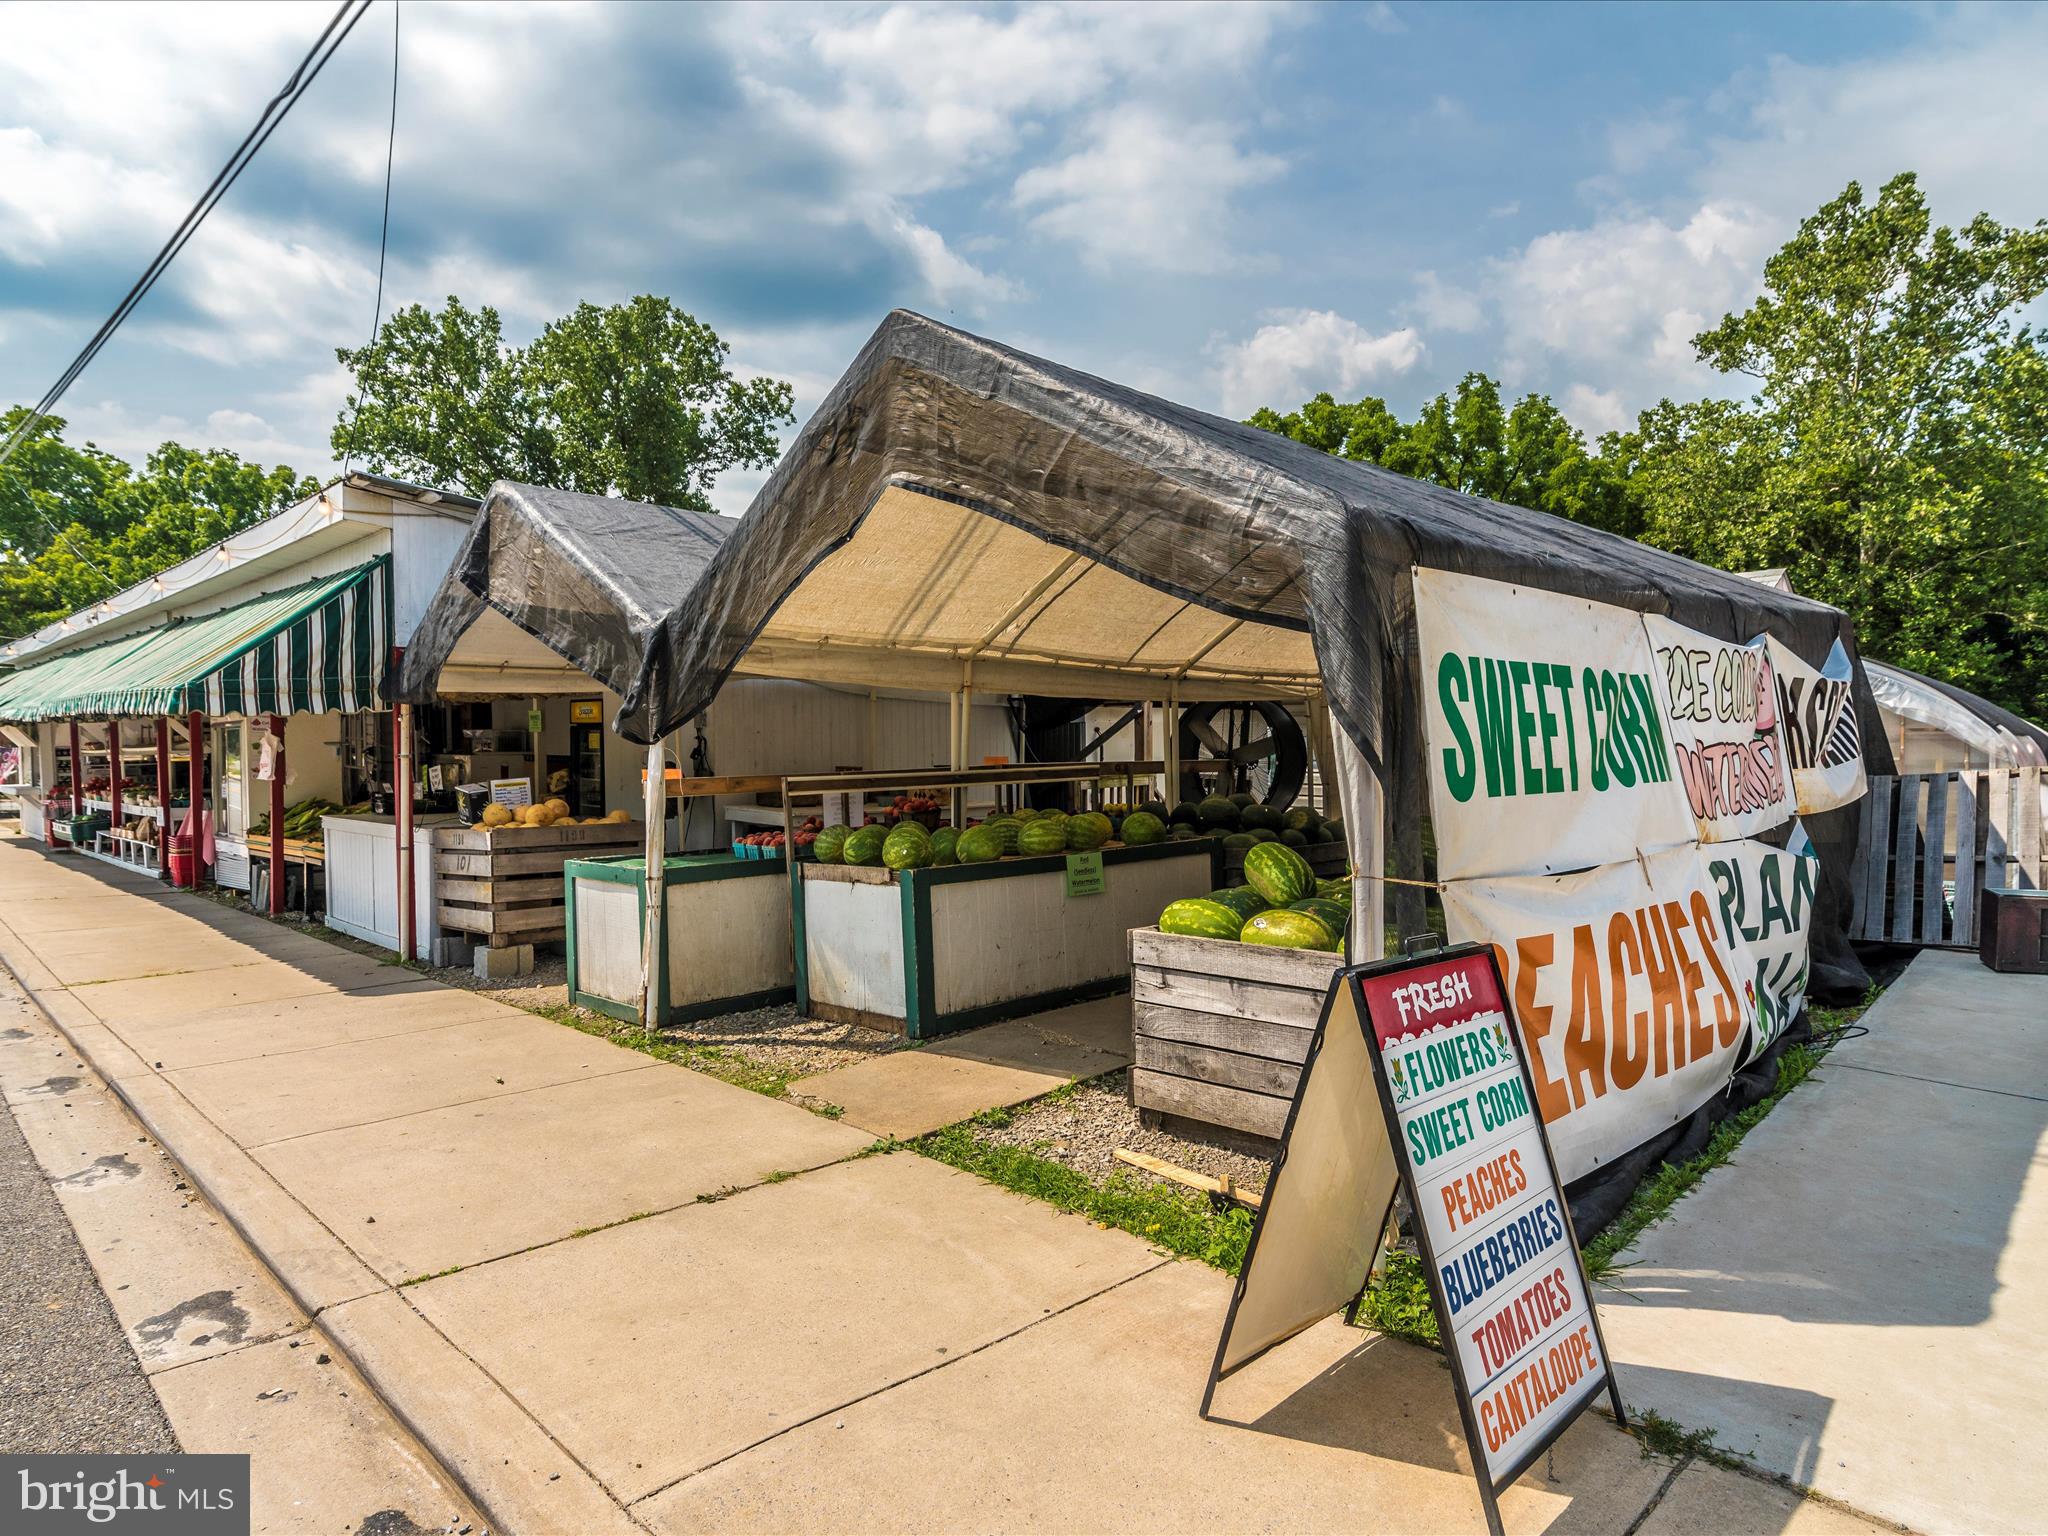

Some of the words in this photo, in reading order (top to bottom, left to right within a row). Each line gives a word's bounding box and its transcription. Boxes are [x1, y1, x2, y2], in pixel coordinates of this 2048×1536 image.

[1438, 652, 1579, 803] SWEET
[1582, 666, 1672, 792] CORN
[1392, 971, 1473, 1028] FRESH
[1493, 890, 1741, 1124] EACHES
[1403, 1027, 1497, 1097] FLOWERS
[1406, 1097, 1476, 1166] SWEET
[1476, 1075, 1530, 1133] CORN
[1440, 1148, 1528, 1233] PEACHES
[1440, 1198, 1564, 1316] BLUEBERRIES
[1471, 1267, 1572, 1378] TOMATOES
[1480, 1324, 1598, 1453] CANTALOUPE
